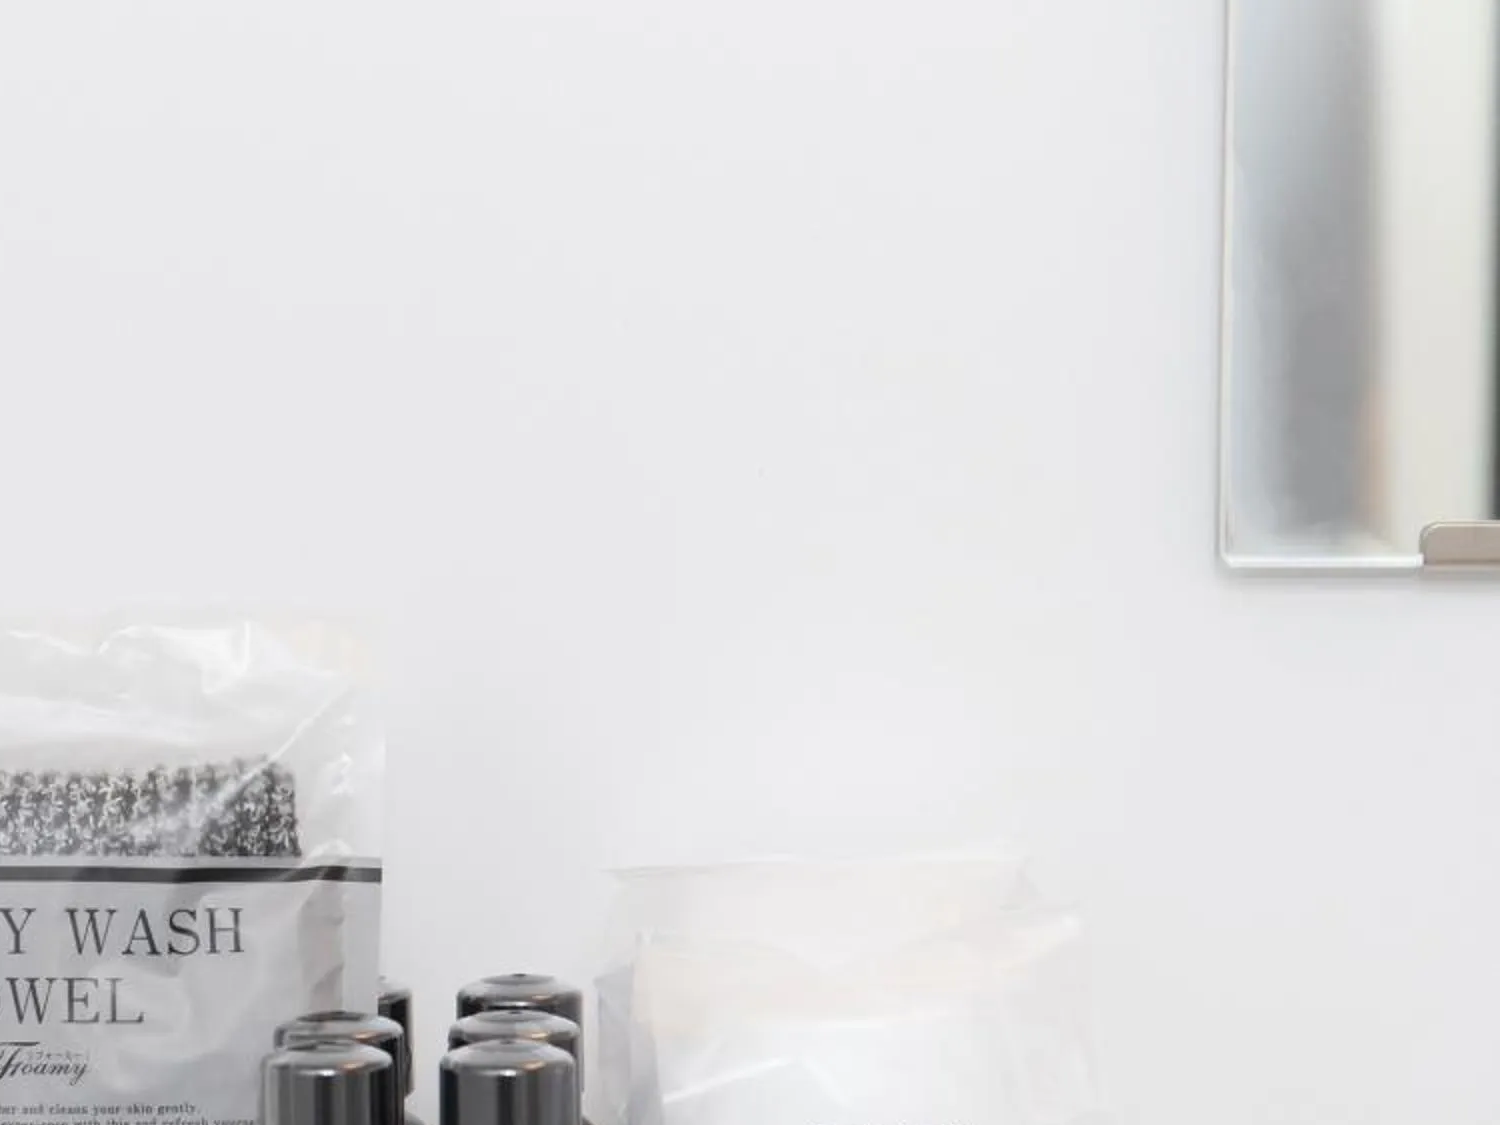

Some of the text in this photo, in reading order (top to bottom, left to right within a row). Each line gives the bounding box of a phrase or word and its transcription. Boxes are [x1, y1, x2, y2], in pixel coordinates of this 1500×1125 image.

[64, 906, 246, 957] WASH
[22, 1103, 44, 1115] and
[93, 1105, 121, 1117] your
[127, 1103, 153, 1115] skin
